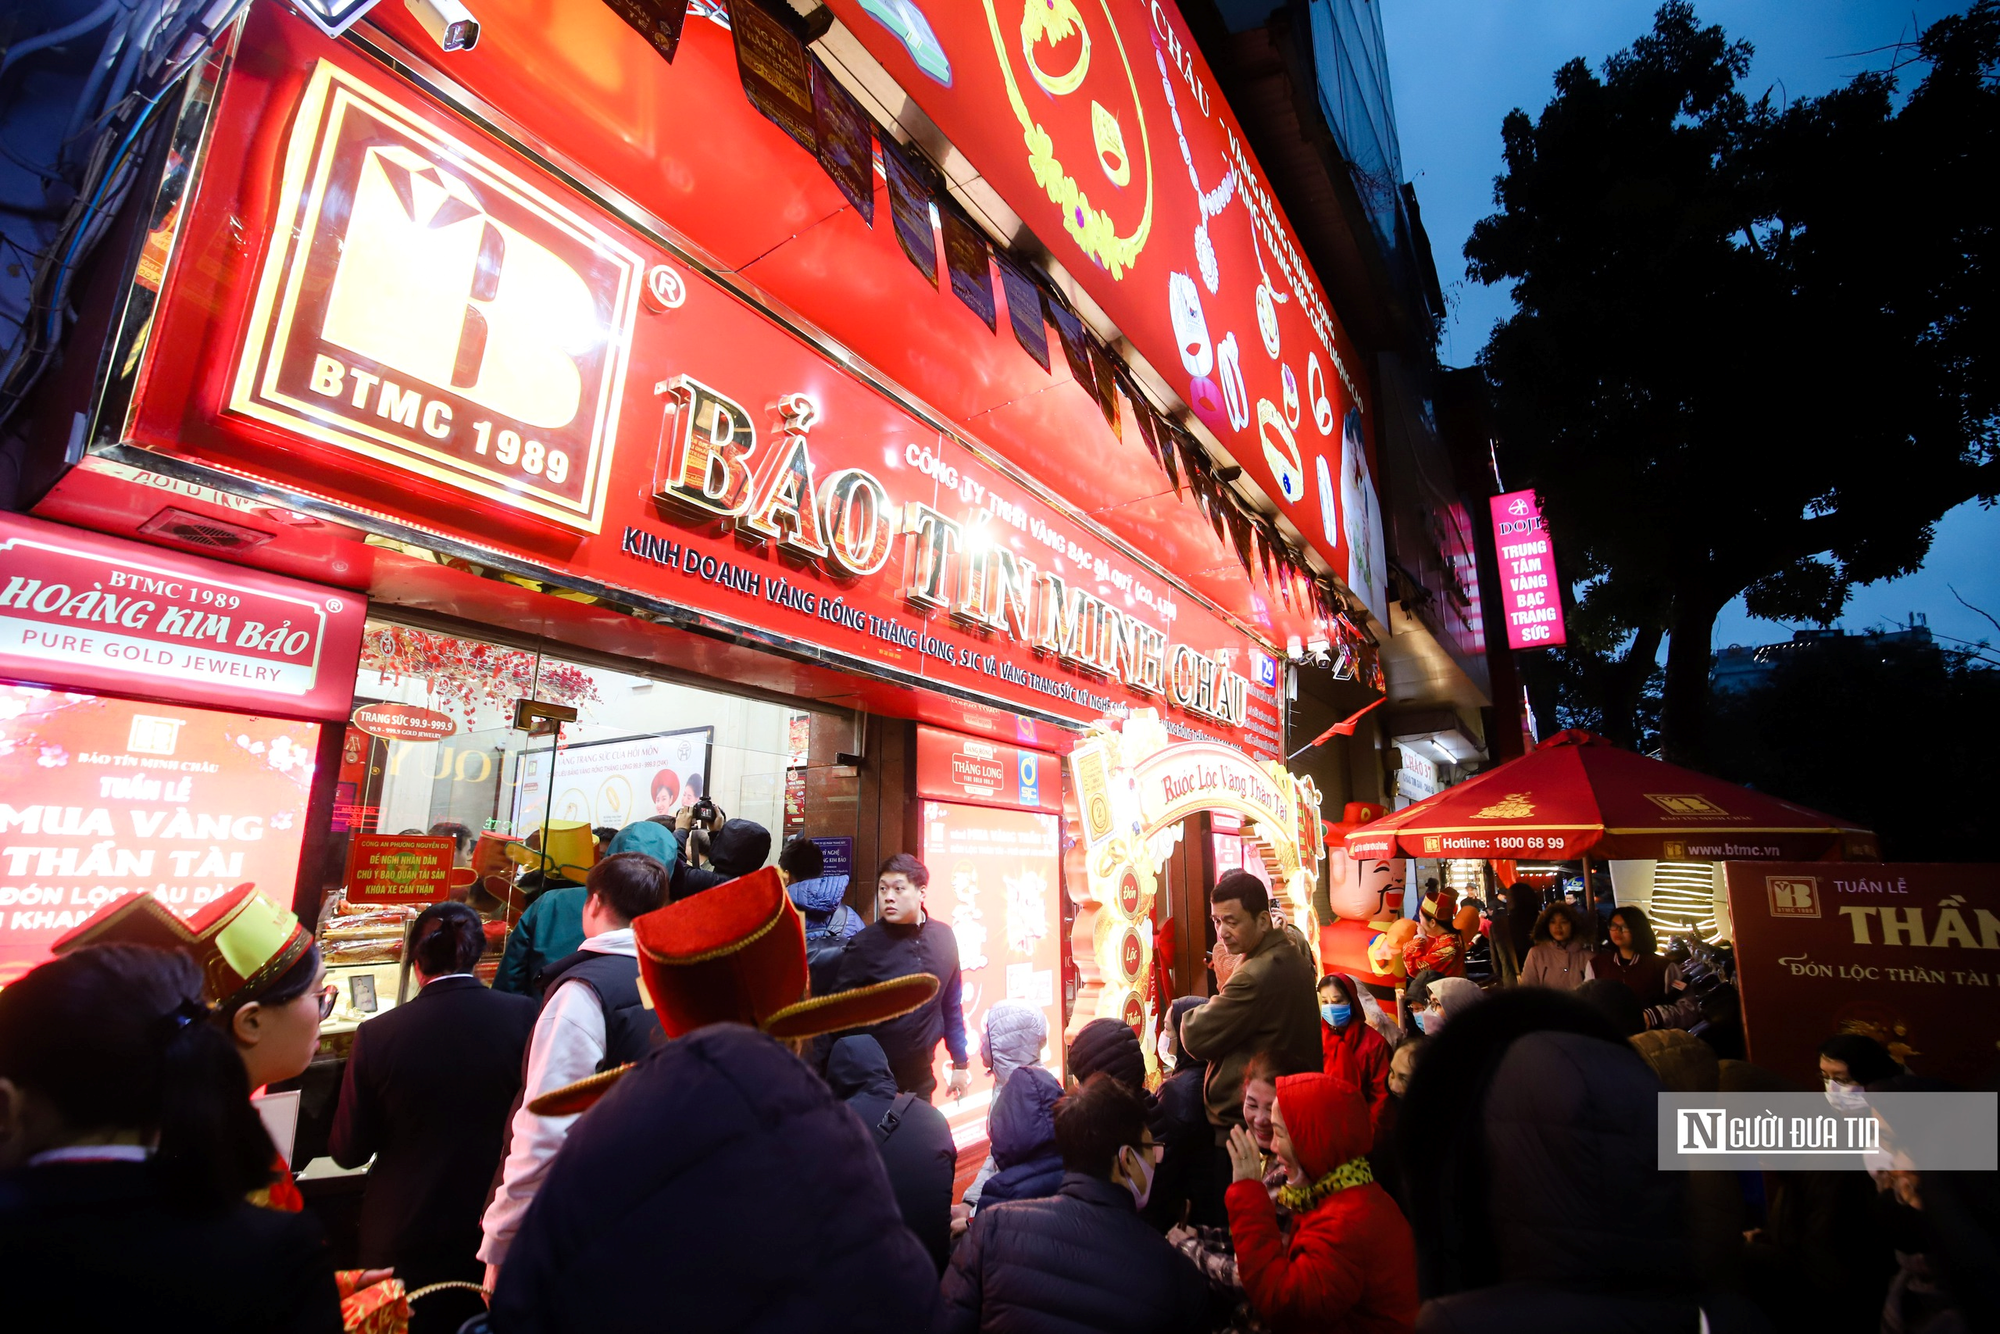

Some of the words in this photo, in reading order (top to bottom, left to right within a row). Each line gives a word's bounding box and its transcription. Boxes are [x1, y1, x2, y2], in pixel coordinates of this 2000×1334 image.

[308, 352, 455, 440] BTMC
[472, 419, 571, 487] 1989
[904, 443, 959, 490] CÔNG
[961, 475, 986, 505] TY
[1029, 519, 1066, 552] VÀNG
[1066, 541, 1093, 570] BẠC
[654, 373, 895, 577] BẢO
[905, 500, 1038, 641] TÍN
[1037, 570, 1167, 696] MINH
[1165, 643, 1249, 728] CHÂU
[1502, 540, 1548, 560] TRUNG
[1511, 557, 1542, 575] TÂM
[109, 569, 184, 600] BTMC
[188, 586, 242, 612] 1989
[1510, 573, 1548, 592] VÀNG
[1516, 592, 1545, 610] BẠC
[1, 574, 159, 631] HOÀNG
[156, 604, 230, 646] KIM
[236, 619, 312, 659] BẢO
[621, 525, 681, 568] KINH
[682, 547, 761, 597] DOANH
[764, 576, 816, 615] VÀNG
[817, 596, 866, 632] RỒNG
[868, 614, 918, 650] THĂNG
[919, 633, 958, 668] LONG,
[982, 654, 998, 678] VÀ
[999, 660, 1028, 688] VÀNG
[1028, 671, 1059, 700] TRANG
[1058, 680, 1077, 700] SỨC
[1076, 688, 1090, 706] MỸ
[1511, 606, 1557, 626] TRANG
[1521, 624, 1551, 642] SỨC
[21, 628, 94, 655] PURE
[103, 641, 175, 667] GOLD
[182, 653, 283, 684] JEWELRY
[1262, 658, 1275, 682] 29
[360, 710, 391, 725] TRANG
[391, 712, 410, 727] SỨC
[401, 729, 418, 738] GOLD
[417, 730, 443, 740] JEWELRY
[77, 752, 111, 766] BẢO
[113, 754, 139, 768] TÍN
[140, 757, 180, 771] MINH
[180, 759, 220, 774] CHÂU
[953, 761, 981, 776] THĂNG
[982, 766, 1003, 780] LONG
[99, 772, 162, 801] TUẦN
[1196, 764, 1218, 794] Lộc
[1219, 764, 1247, 800] Vàng
[0, 804, 116, 837] MUA
[129, 806, 264, 842] VÀNG
[361, 840, 379, 848] CÔNG
[1442, 838, 1490, 849] Hotline:
[1493, 837, 1524, 849] 1800
[1526, 837, 1545, 849] 68
[1547, 837, 1565, 850] 99
[1687, 842, 1781, 857] www.btmc.vn
[2, 839, 156, 878] THẦN
[168, 845, 245, 878] TÀI
[381, 854, 399, 867] NGHỊ
[400, 853, 421, 865] NHÂN
[422, 854, 438, 866] DÂN
[356, 869, 372, 880] CHÚ
[374, 868, 381, 880] Ý
[418, 868, 430, 880] TÀI
[0, 883, 64, 906] ĐÓN
[387, 885, 397, 894] XE
[415, 884, 435, 896] THẬN
[1122, 885, 1138, 902] Đón
[1832, 875, 1884, 894] TUẦN
[1887, 876, 1909, 894] LỄ
[1838, 894, 2000, 950] THẦN
[1125, 946, 1138, 964] Lộc
[1784, 956, 1833, 978] ĐÓN
[1838, 963, 1880, 983] LỘC
[1885, 965, 1947, 985] THẦN
[1952, 967, 1990, 987] TÀI
